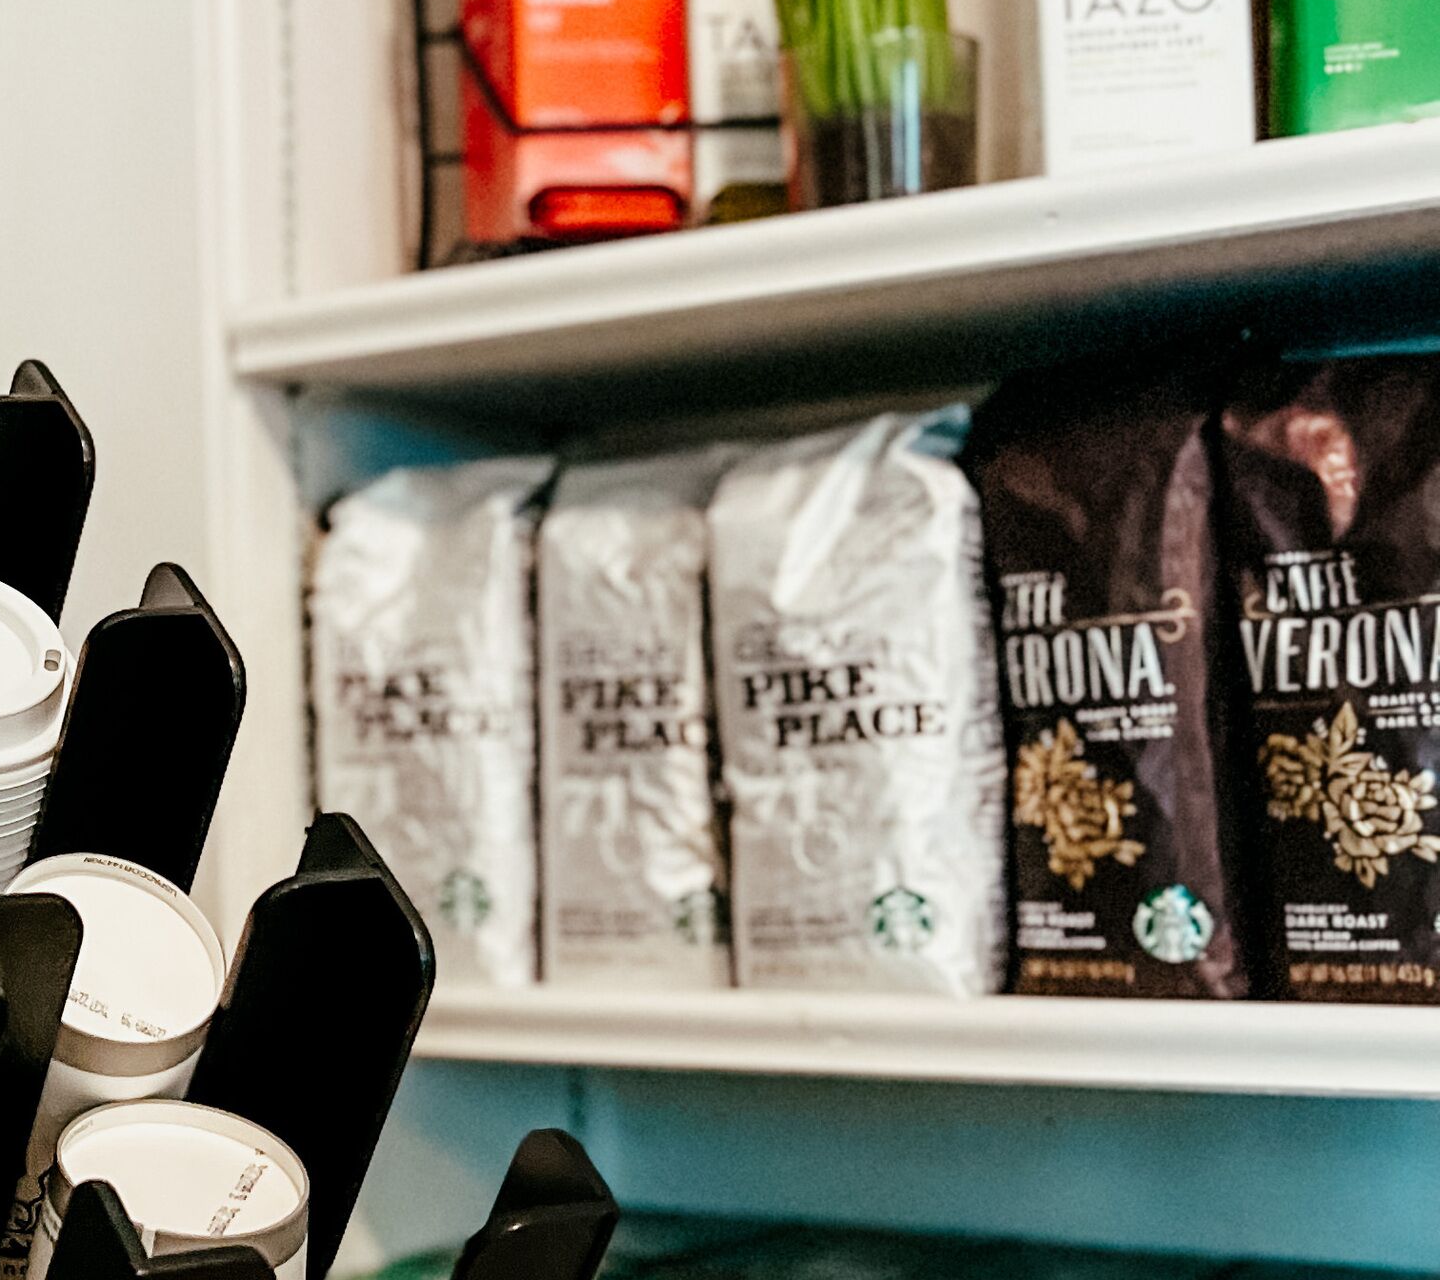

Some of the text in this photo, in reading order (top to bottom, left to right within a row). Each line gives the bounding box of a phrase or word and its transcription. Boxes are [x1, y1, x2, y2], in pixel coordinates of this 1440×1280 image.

[742, 660, 876, 709] PIKE
[777, 702, 946, 747] PLACE
[1331, 913, 1389, 930] ROAST
